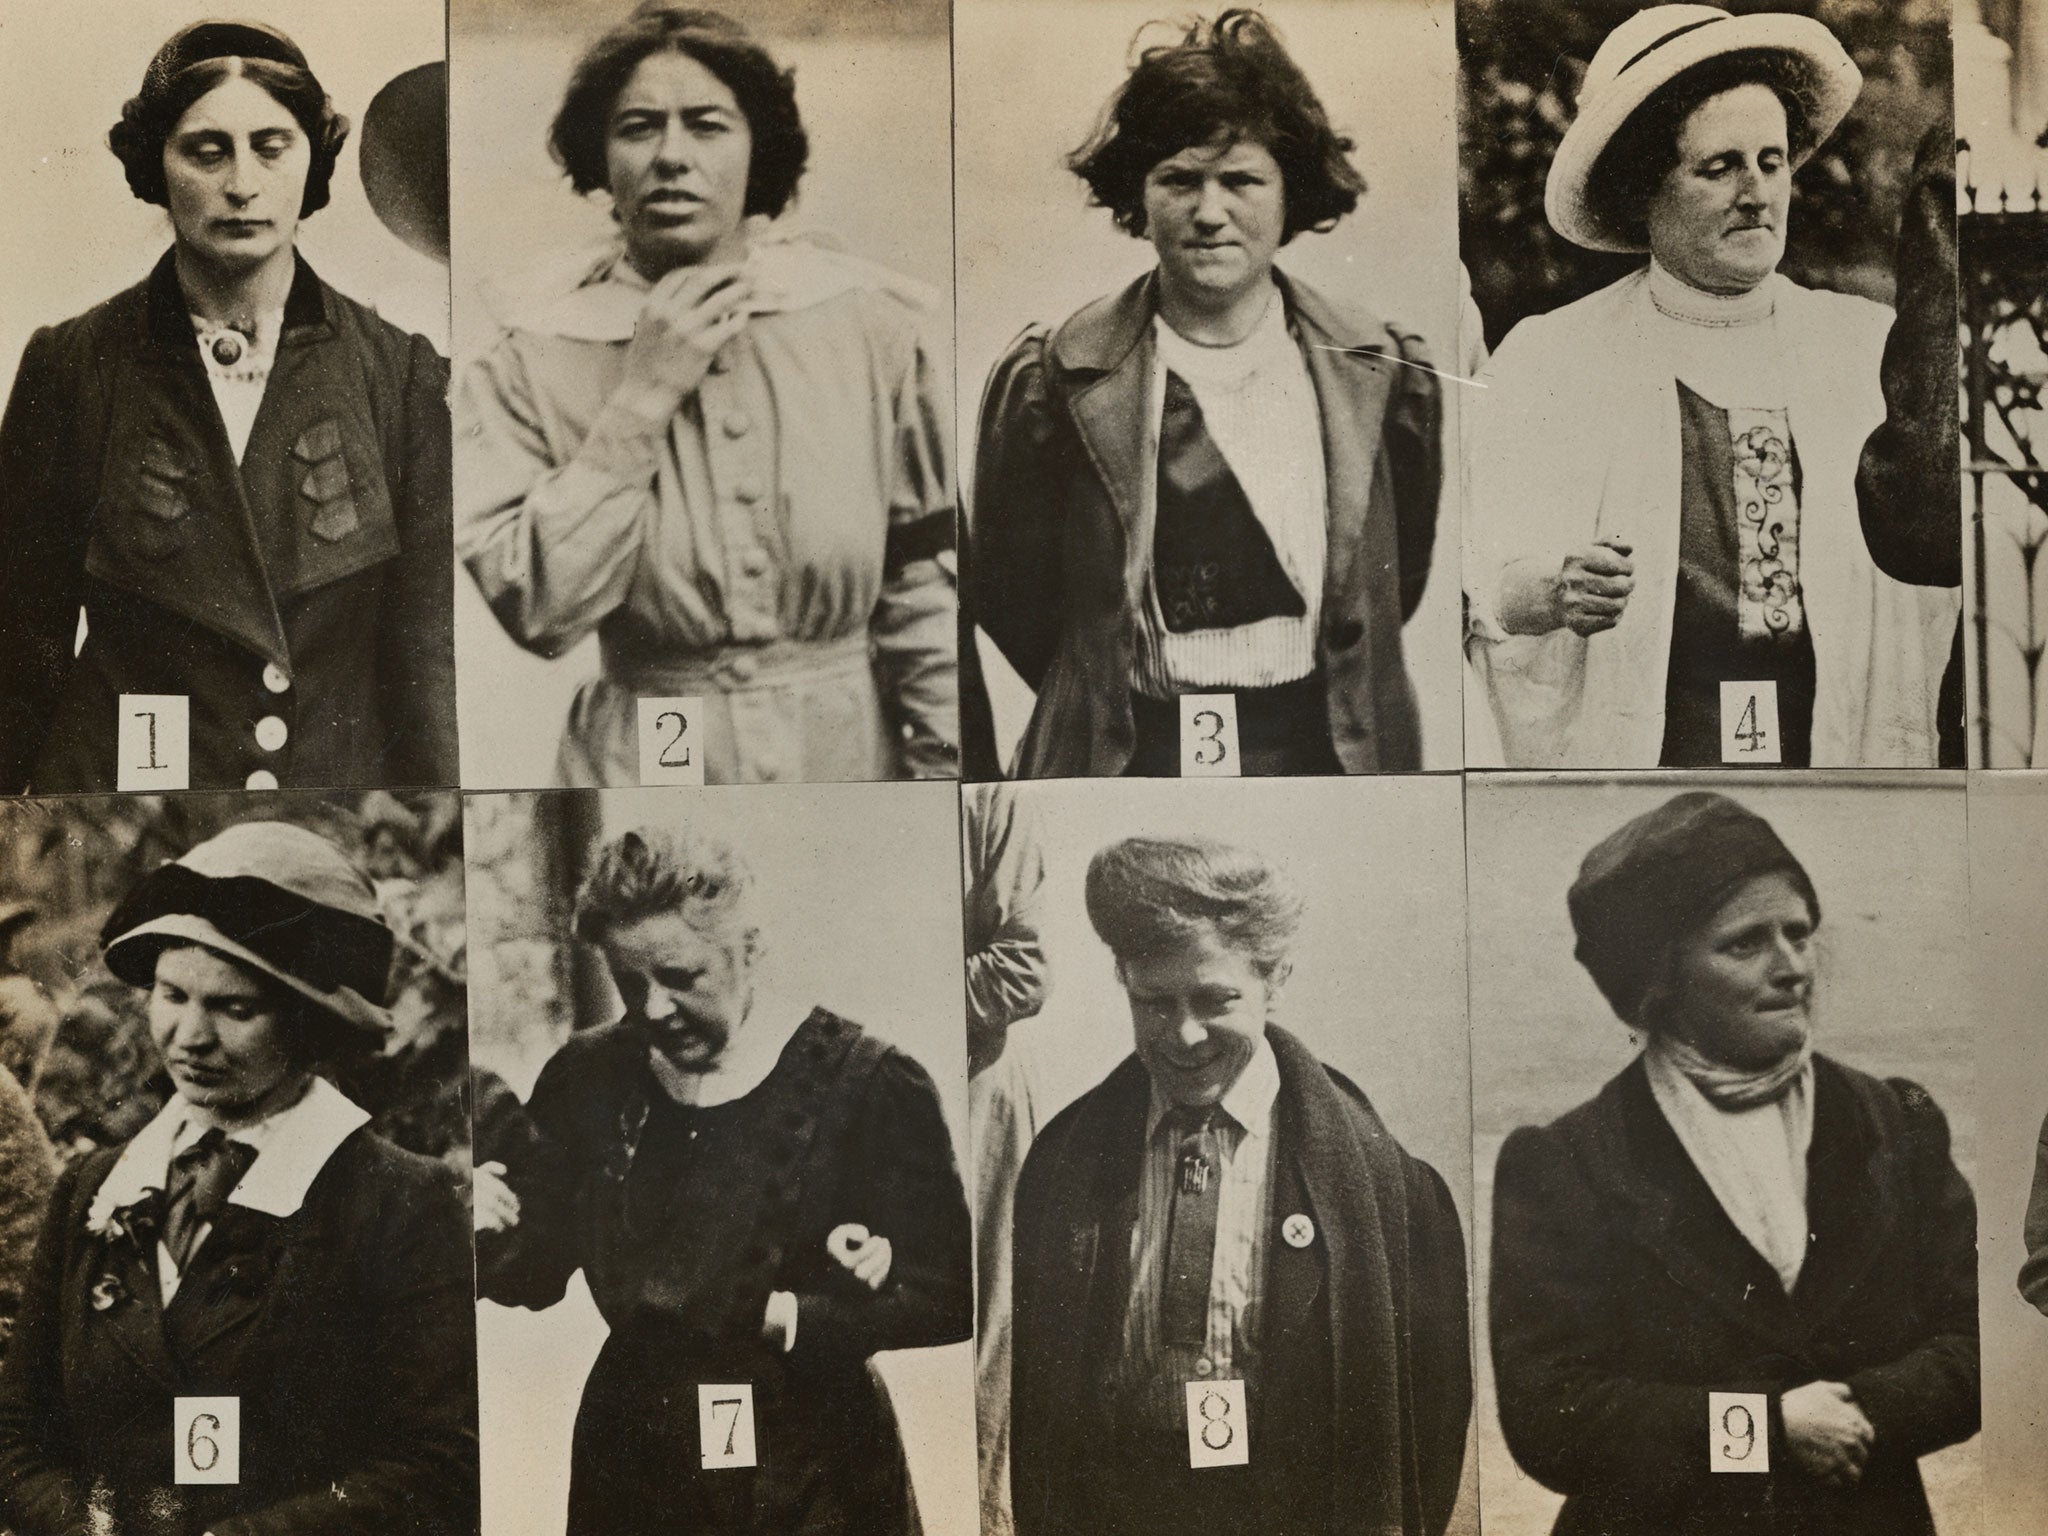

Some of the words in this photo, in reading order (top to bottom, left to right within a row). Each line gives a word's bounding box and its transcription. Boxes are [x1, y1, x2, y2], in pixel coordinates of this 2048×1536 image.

[134, 712, 168, 769] 1
[655, 711, 691, 767] 2
[1193, 710, 1226, 765] 3
[1734, 695, 1766, 752] 4
[187, 1413, 221, 1472] 6
[711, 1398, 742, 1455] 7
[1199, 1391, 1234, 1451] 8
[1722, 1404, 1755, 1461] 9
